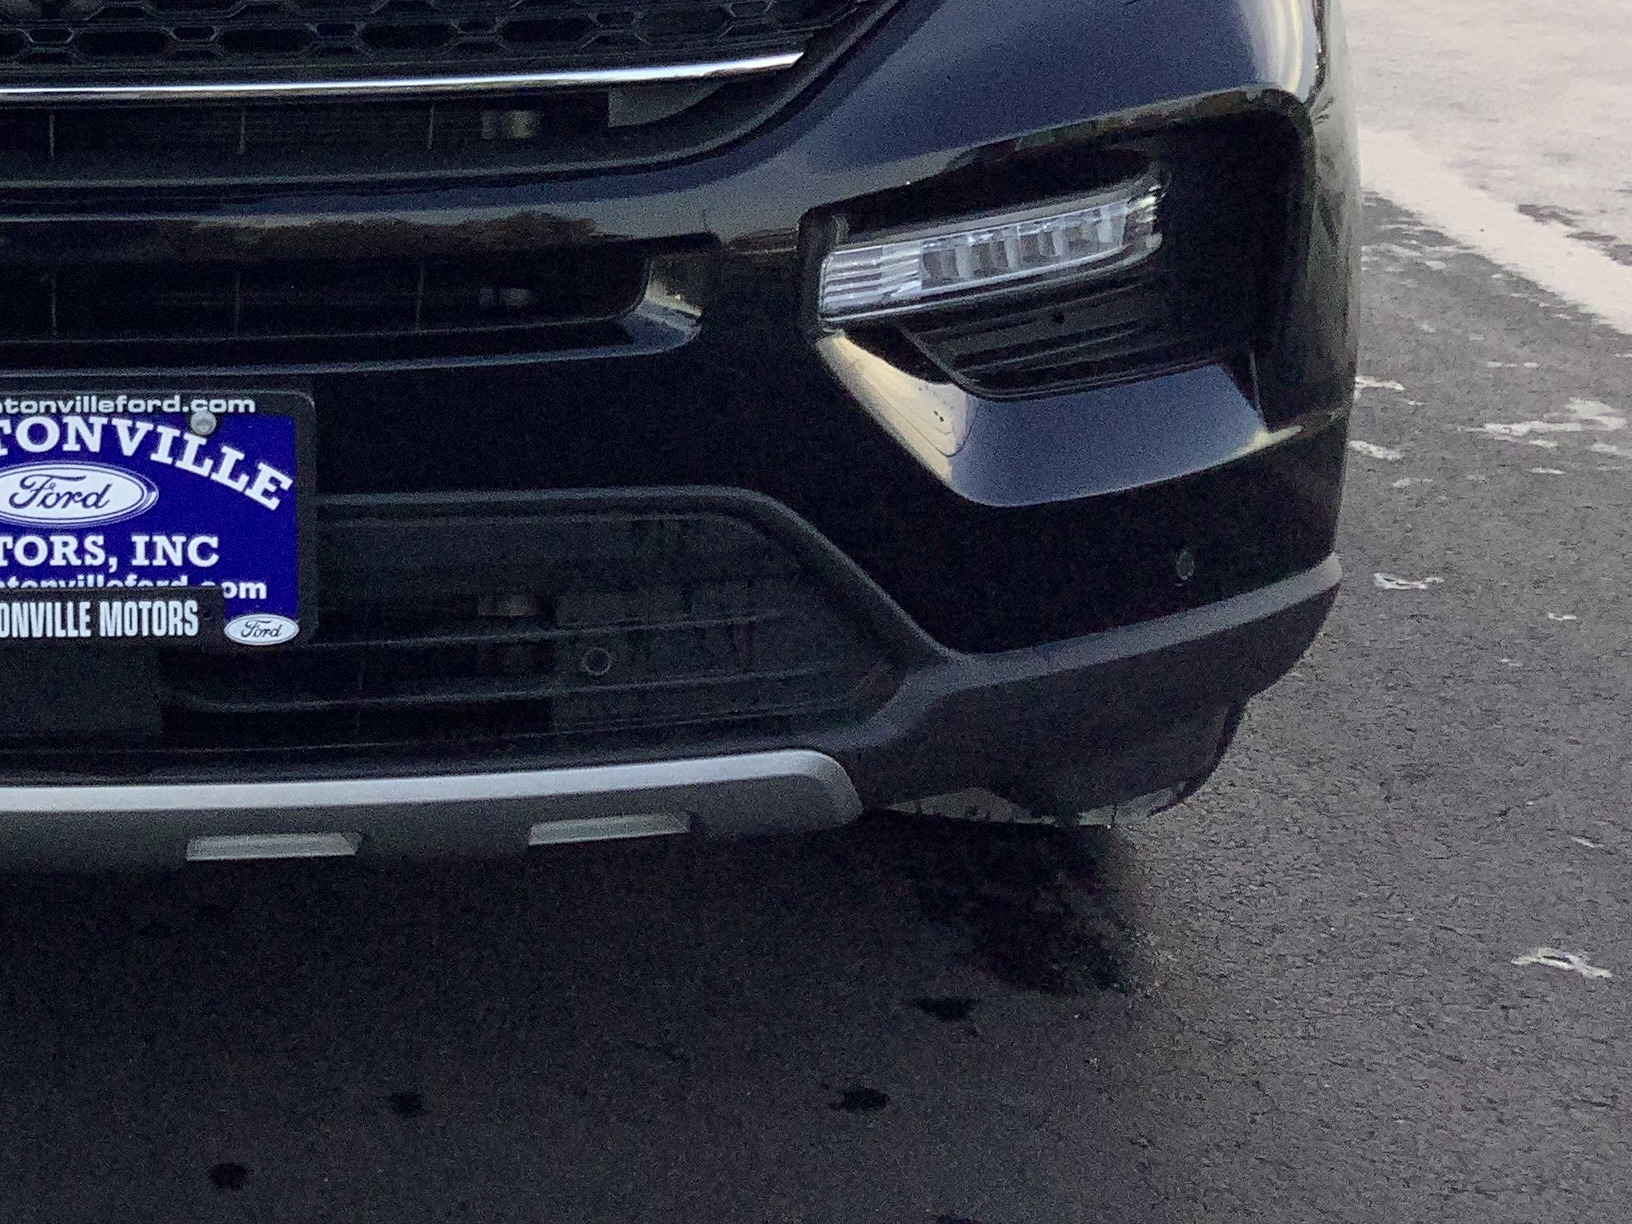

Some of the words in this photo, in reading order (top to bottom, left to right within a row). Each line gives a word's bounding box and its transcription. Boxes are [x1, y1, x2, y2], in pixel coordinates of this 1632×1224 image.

[8, 474, 113, 509] Ford
[131, 534, 220, 568] INC
[99, 599, 200, 637] MOTORS
[240, 619, 283, 639] Ford
